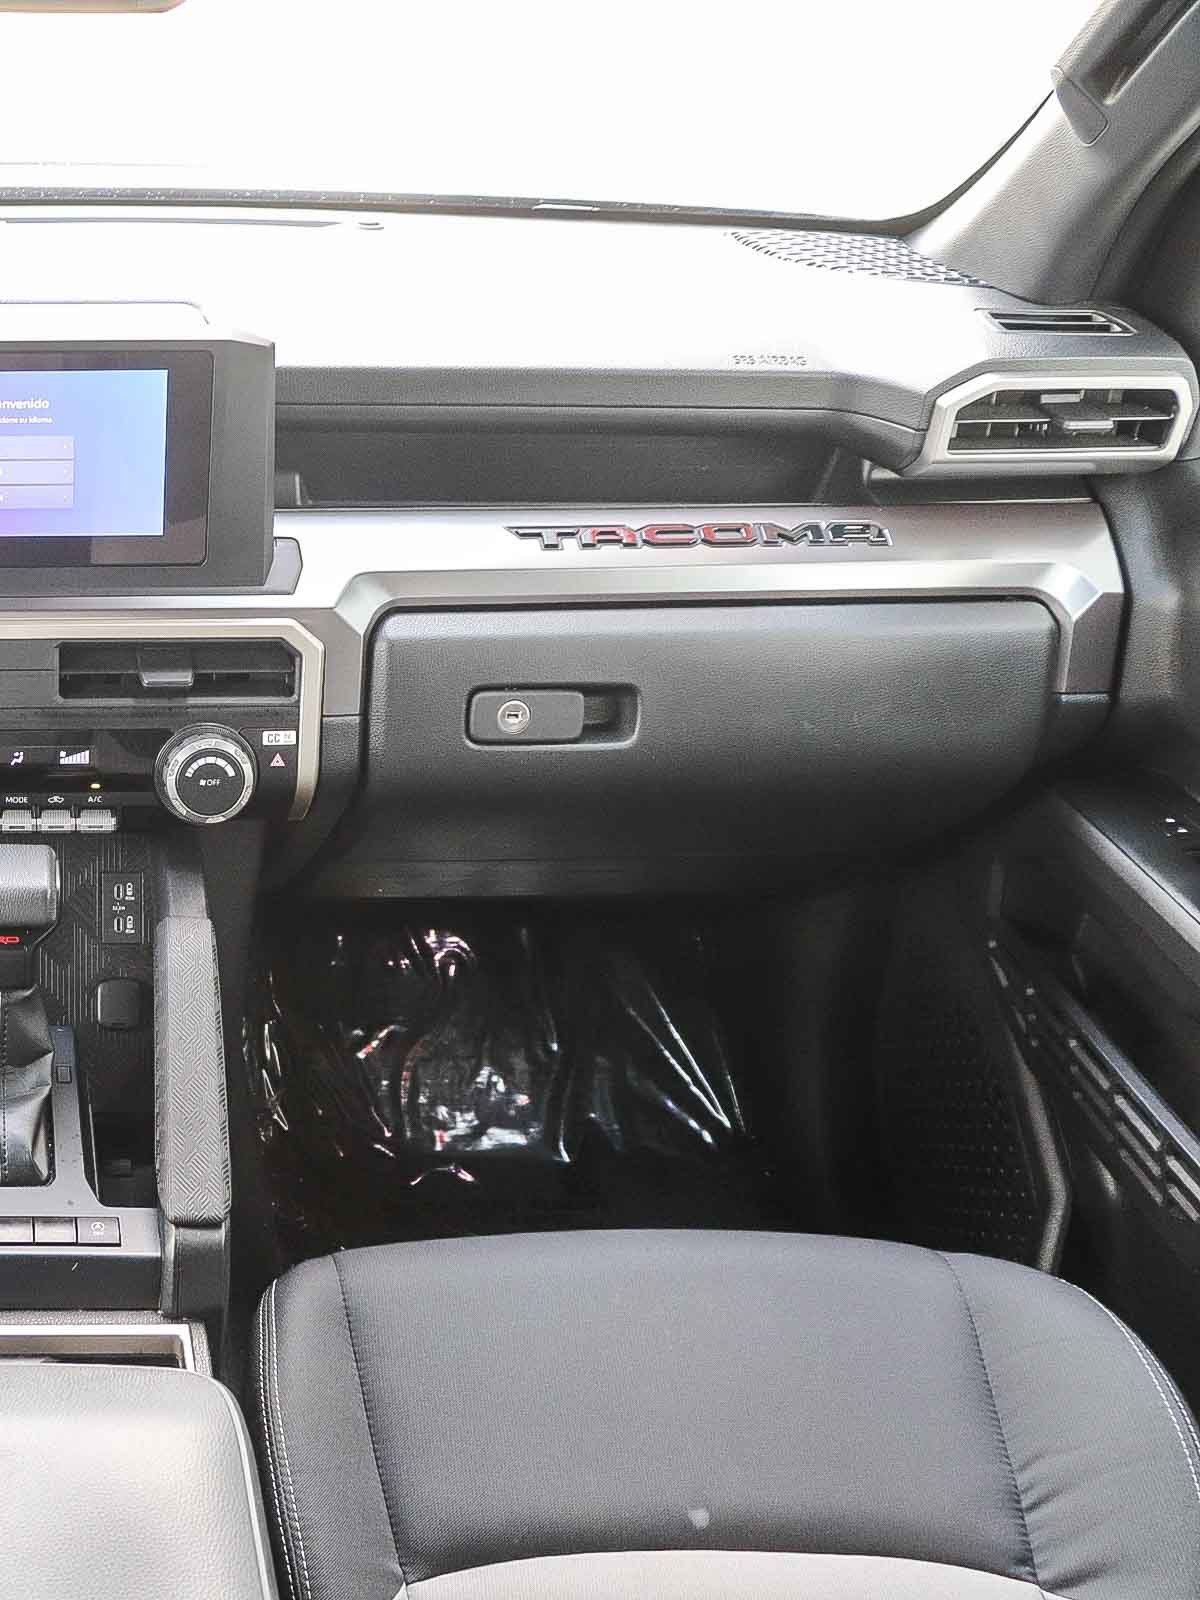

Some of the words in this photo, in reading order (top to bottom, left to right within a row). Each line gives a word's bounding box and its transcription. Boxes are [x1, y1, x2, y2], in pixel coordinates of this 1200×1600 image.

[505, 519, 895, 551] TACOMA
[207, 779, 221, 787] OFF
[5, 796, 29, 804] MODE
[87, 795, 103, 803] A/C
